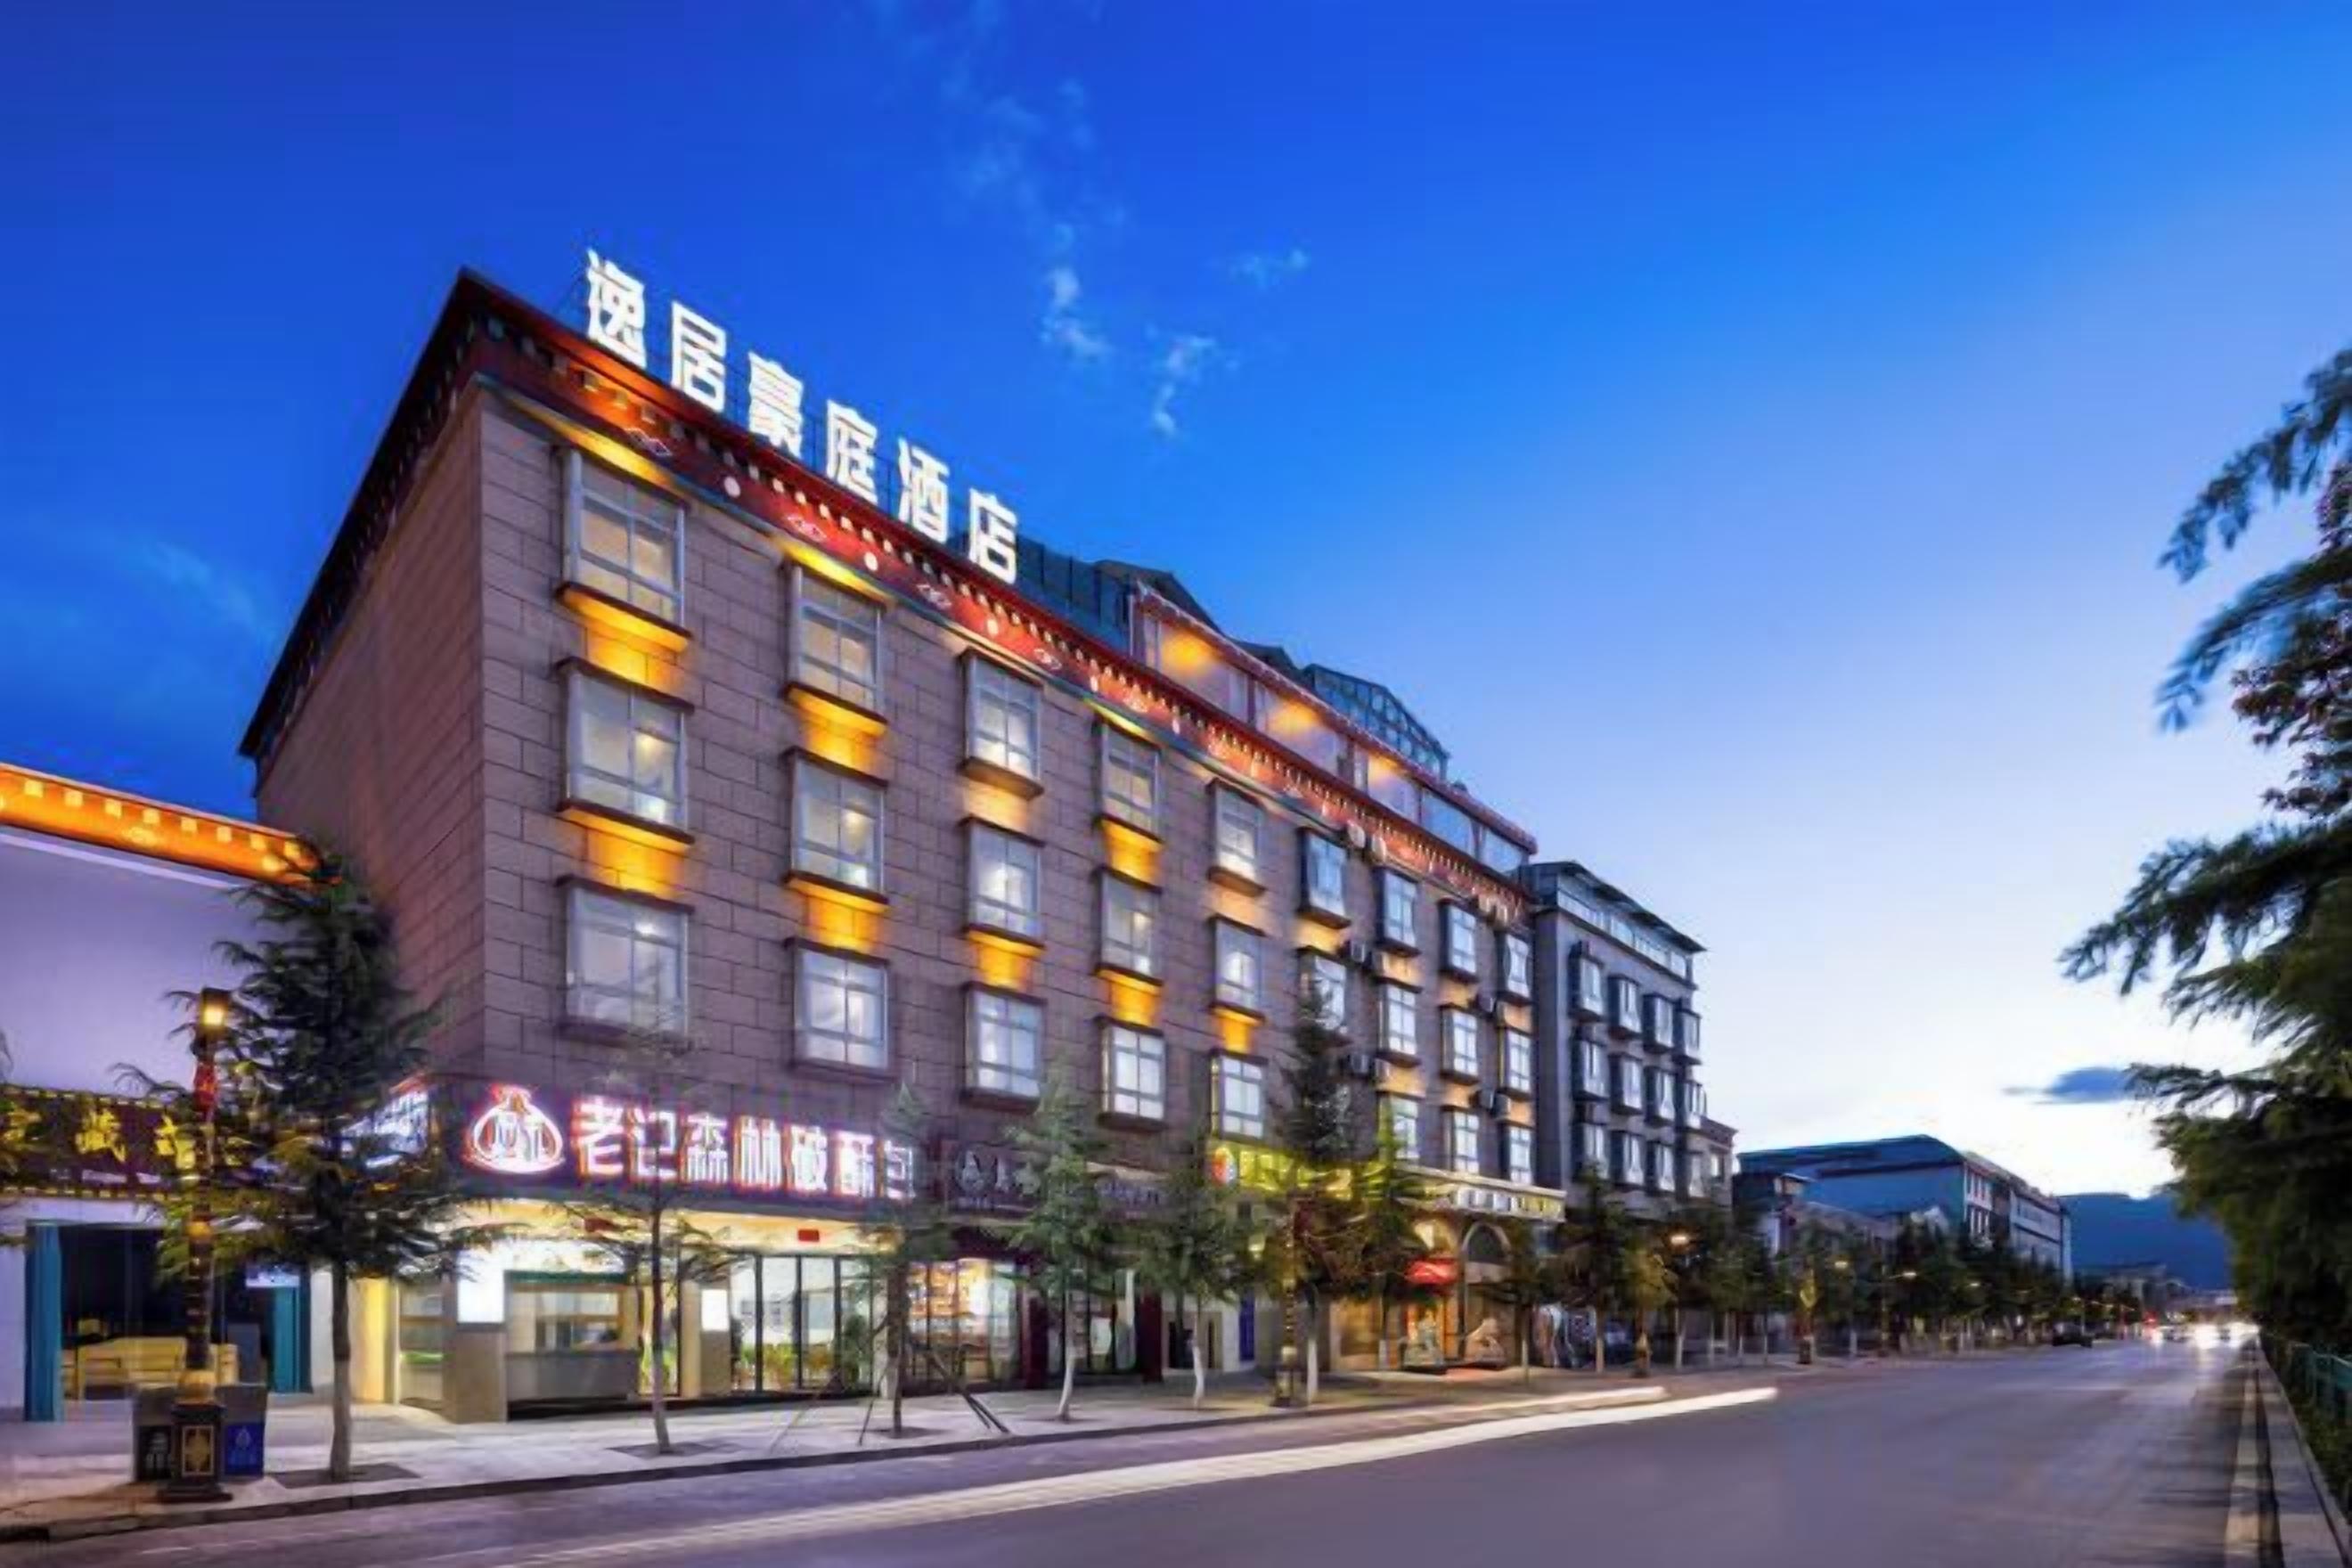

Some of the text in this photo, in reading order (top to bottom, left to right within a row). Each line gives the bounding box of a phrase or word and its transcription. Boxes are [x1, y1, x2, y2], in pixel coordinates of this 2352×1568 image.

[586, 249, 1017, 584] 逸居豪庭酒店
